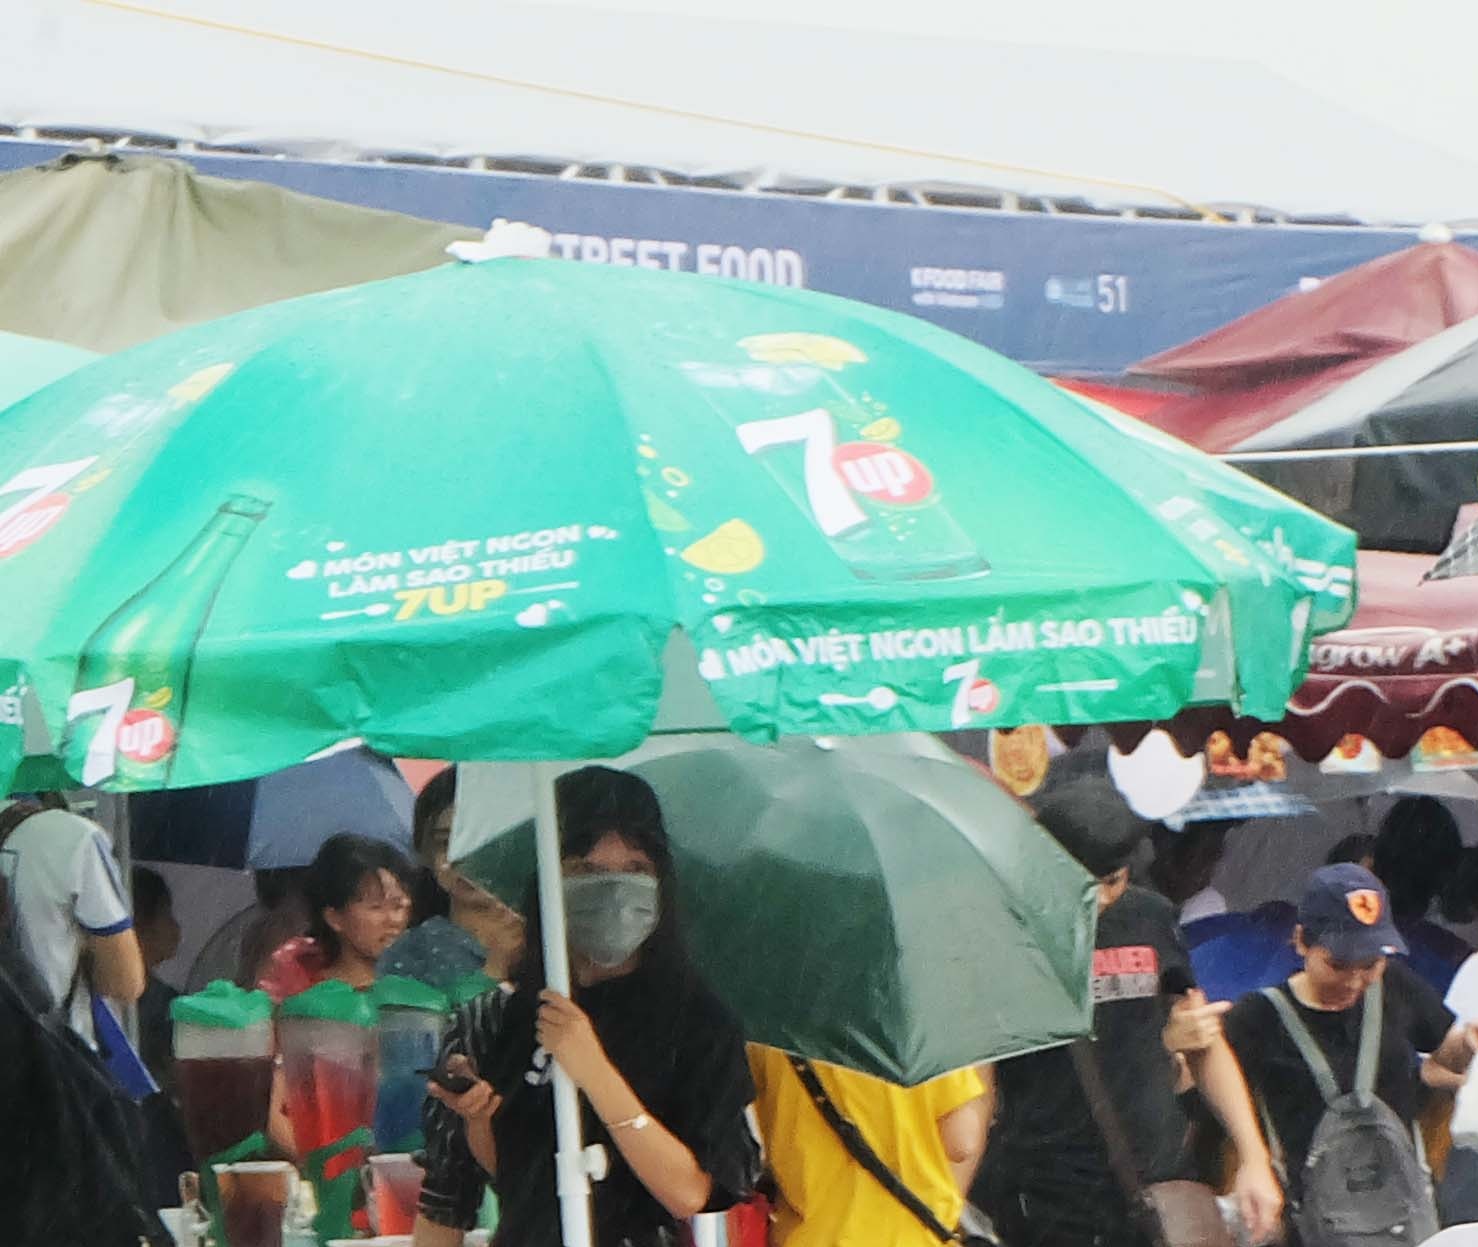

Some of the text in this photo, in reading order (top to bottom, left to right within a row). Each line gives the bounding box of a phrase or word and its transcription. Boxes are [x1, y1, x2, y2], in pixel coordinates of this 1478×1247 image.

[1097, 273, 1128, 313] 51
[324, 551, 402, 577] MÓN
[408, 538, 480, 565] VIỆT
[406, 564, 472, 588] SAO
[478, 549, 576, 578] THIẾU
[393, 578, 507, 621] 7UP
[792, 628, 865, 671] VIỆT
[870, 627, 964, 660] NGON
[1041, 619, 1102, 648] SAO
